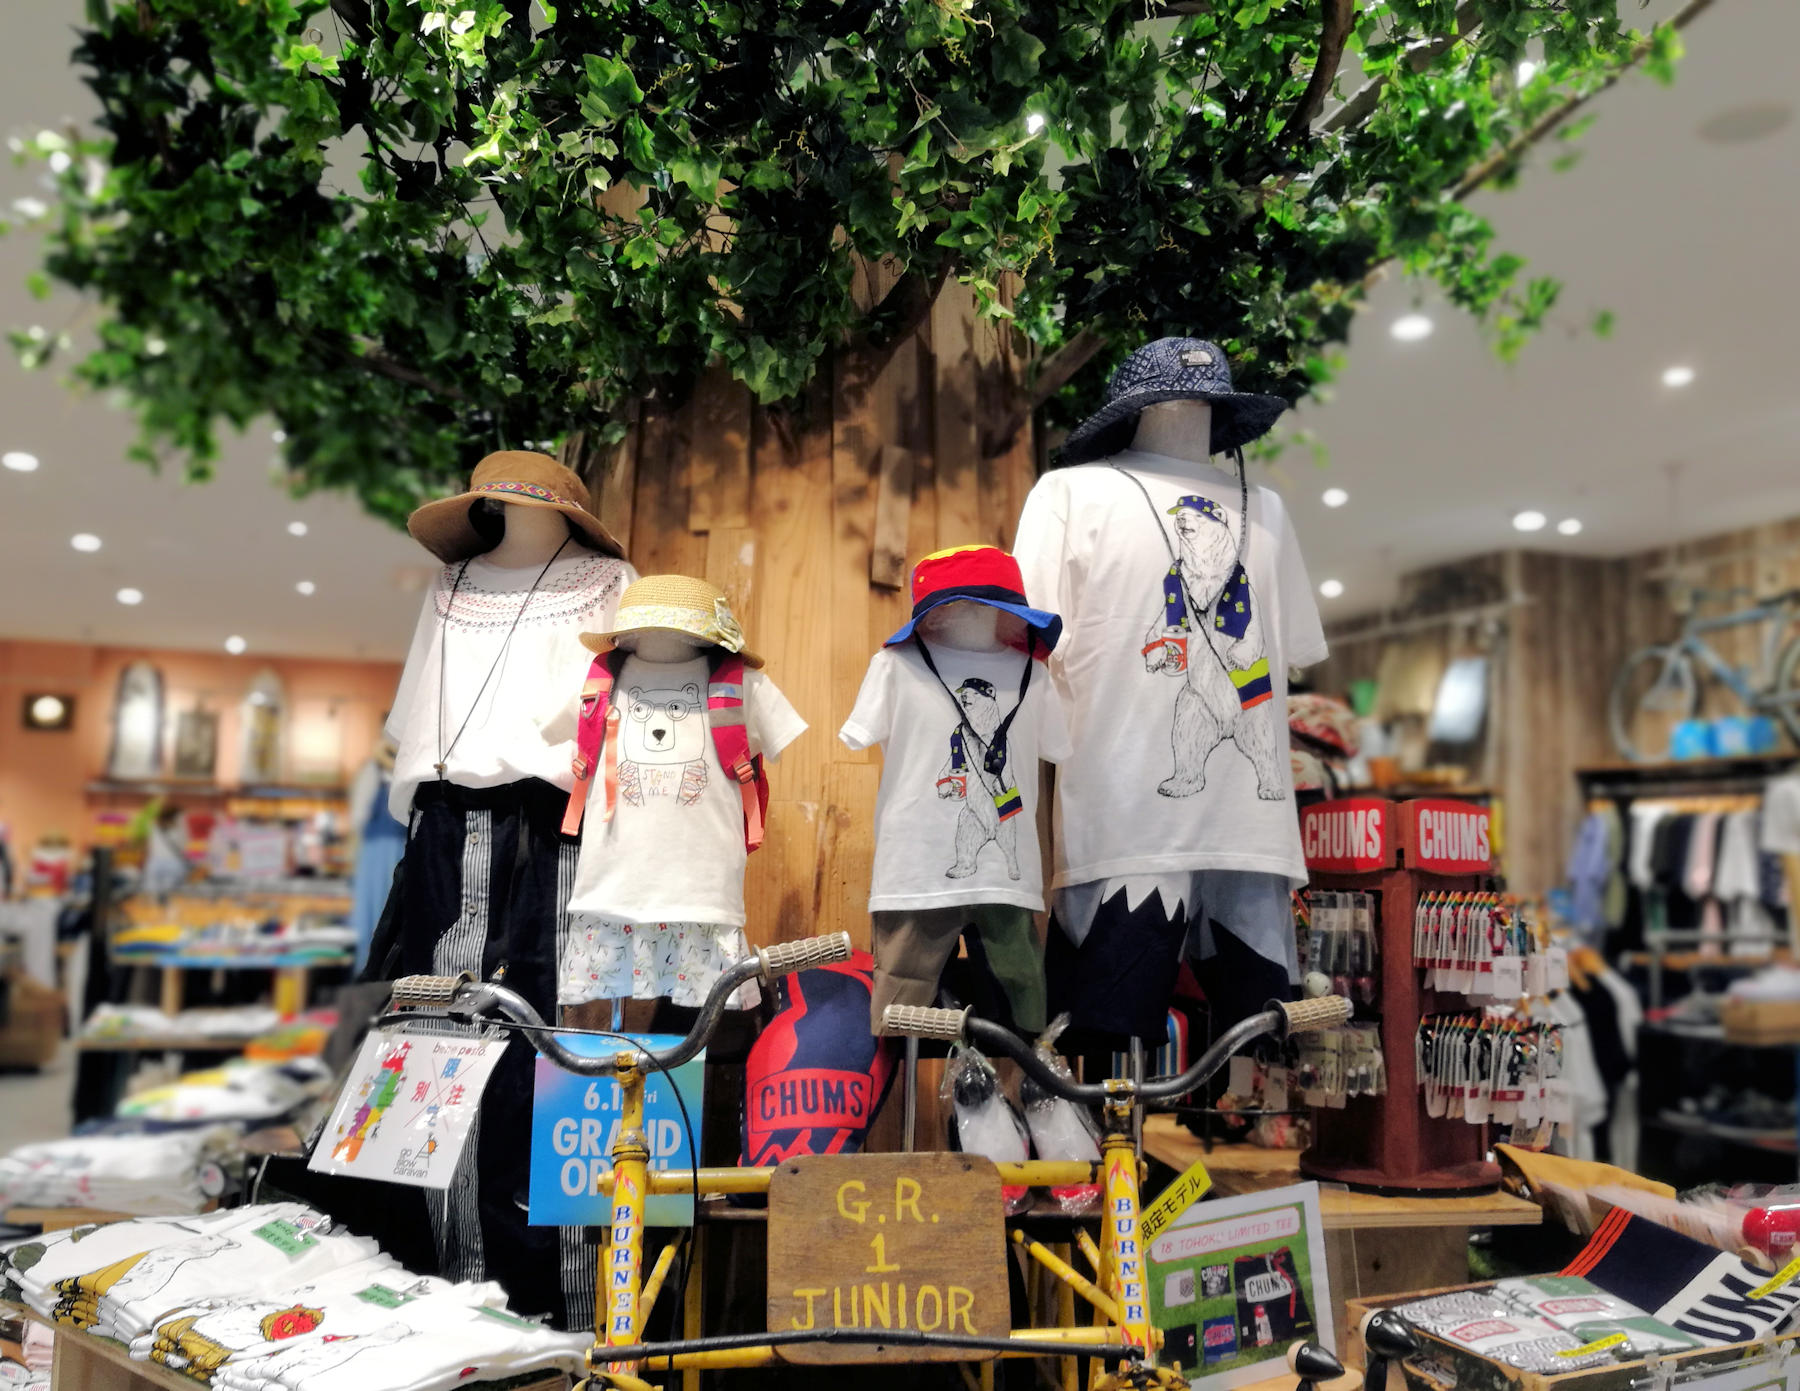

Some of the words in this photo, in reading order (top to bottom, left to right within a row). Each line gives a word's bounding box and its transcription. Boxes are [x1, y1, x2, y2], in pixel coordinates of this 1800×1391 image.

[1304, 808, 1381, 859] CHUMS
[1419, 808, 1491, 862] CHUMS
[584, 1082, 624, 1111] 6.1
[760, 1078, 863, 1121] CHUMS
[836, 1176, 940, 1224] G.R.
[866, 1232, 901, 1273] 1
[1228, 1222, 1270, 1241] LIMITED
[1276, 1217, 1293, 1233] TEE
[613, 1204, 634, 1335] BURNER
[1115, 1198, 1143, 1322] BURNER
[791, 1282, 979, 1335] JUNIOR
[1249, 1274, 1288, 1298] CHUMS
